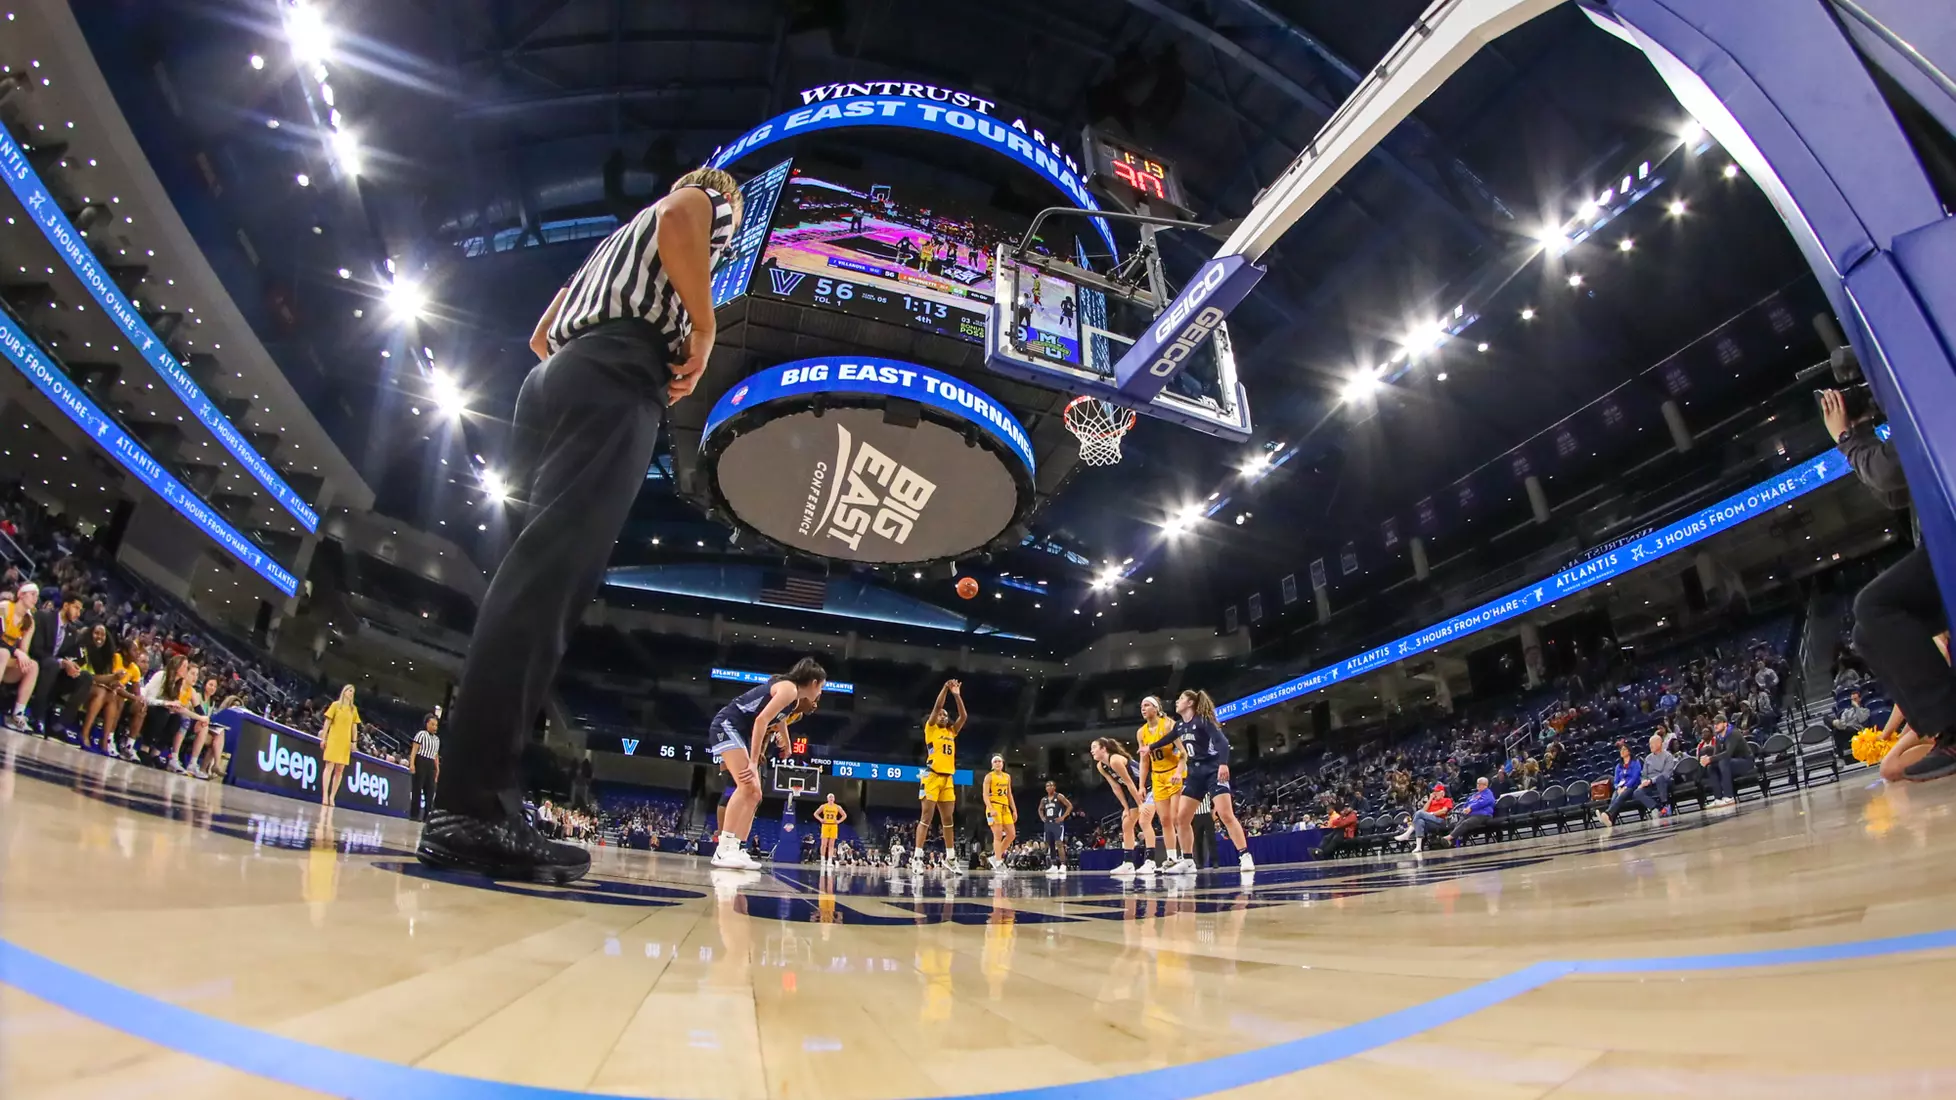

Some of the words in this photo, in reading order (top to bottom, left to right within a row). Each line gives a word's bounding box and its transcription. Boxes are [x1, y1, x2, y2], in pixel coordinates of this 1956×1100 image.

[799, 82, 995, 115] WINTRUST
[713, 124, 774, 171] BIG
[783, 101, 906, 131] EAST
[1123, 151, 1165, 179] 1:13
[46, 215, 57, 227] 3
[53, 223, 84, 265] HOURS
[81, 261, 108, 296] FROM
[105, 292, 136, 331] O'HARE
[814, 278, 854, 300] 56
[814, 295, 831, 304] TOL
[903, 296, 948, 319] 1:13
[1154, 261, 1226, 344] GEICO
[914, 315, 932, 325] 4th
[960, 316, 971, 324] 03
[960, 322, 985, 334] BONUS
[960, 328, 985, 339] POSS
[1149, 306, 1225, 378] GEICO
[0, 326, 26, 359] OURS
[24, 353, 54, 386] FROM
[53, 382, 88, 419] O'HARE
[158, 353, 199, 399] ATLANTIS
[780, 364, 829, 387] BIG
[838, 364, 917, 388] EAST
[115, 436, 161, 479] ATLANTIS
[212, 417, 219, 427] 3
[217, 423, 238, 449] HOURS
[237, 443, 255, 466] FROM
[253, 461, 275, 487] O'HARE
[798, 461, 828, 536] CONFERENCE
[827, 441, 899, 552] EAST
[871, 464, 938, 545] BIG
[290, 496, 318, 526] ATLANTIS
[1655, 538, 1663, 549] 3
[1665, 519, 1707, 545] HOURS
[1708, 502, 1746, 526] FROM
[1747, 479, 1796, 508] O'HARE
[179, 494, 185, 505] 3
[183, 500, 208, 524] HOURS
[207, 518, 227, 539] FROM
[225, 533, 248, 556] O'HARE
[266, 563, 296, 590] ATLANTIS
[1556, 554, 1618, 588] ATLANTIS
[1415, 637, 1422, 647] 3
[1422, 626, 1453, 645] HOURS
[1454, 615, 1481, 632] FROM
[1482, 599, 1519, 621] O'HARE
[1347, 646, 1390, 670] ATLANTIS
[712, 669, 741, 678] ATLANTIS
[825, 681, 854, 691] ATLANTIS
[1257, 691, 1278, 705] HOURS
[1278, 685, 1296, 698] FROM
[1296, 675, 1322, 691] O'HARE
[659, 745, 676, 758] 56
[685, 750, 692, 761] 1
[793, 742, 806, 754] 30
[942, 743, 953, 756] 15
[1150, 748, 1165, 762] 10
[257, 734, 317, 791] Jeep
[770, 757, 796, 769] 1:13
[810, 758, 832, 766] PERIOD
[832, 760, 846, 768] TEAM
[839, 767, 853, 777] 03
[870, 768, 878, 779] 3
[886, 767, 902, 779] 69
[348, 762, 389, 806] Jeep
